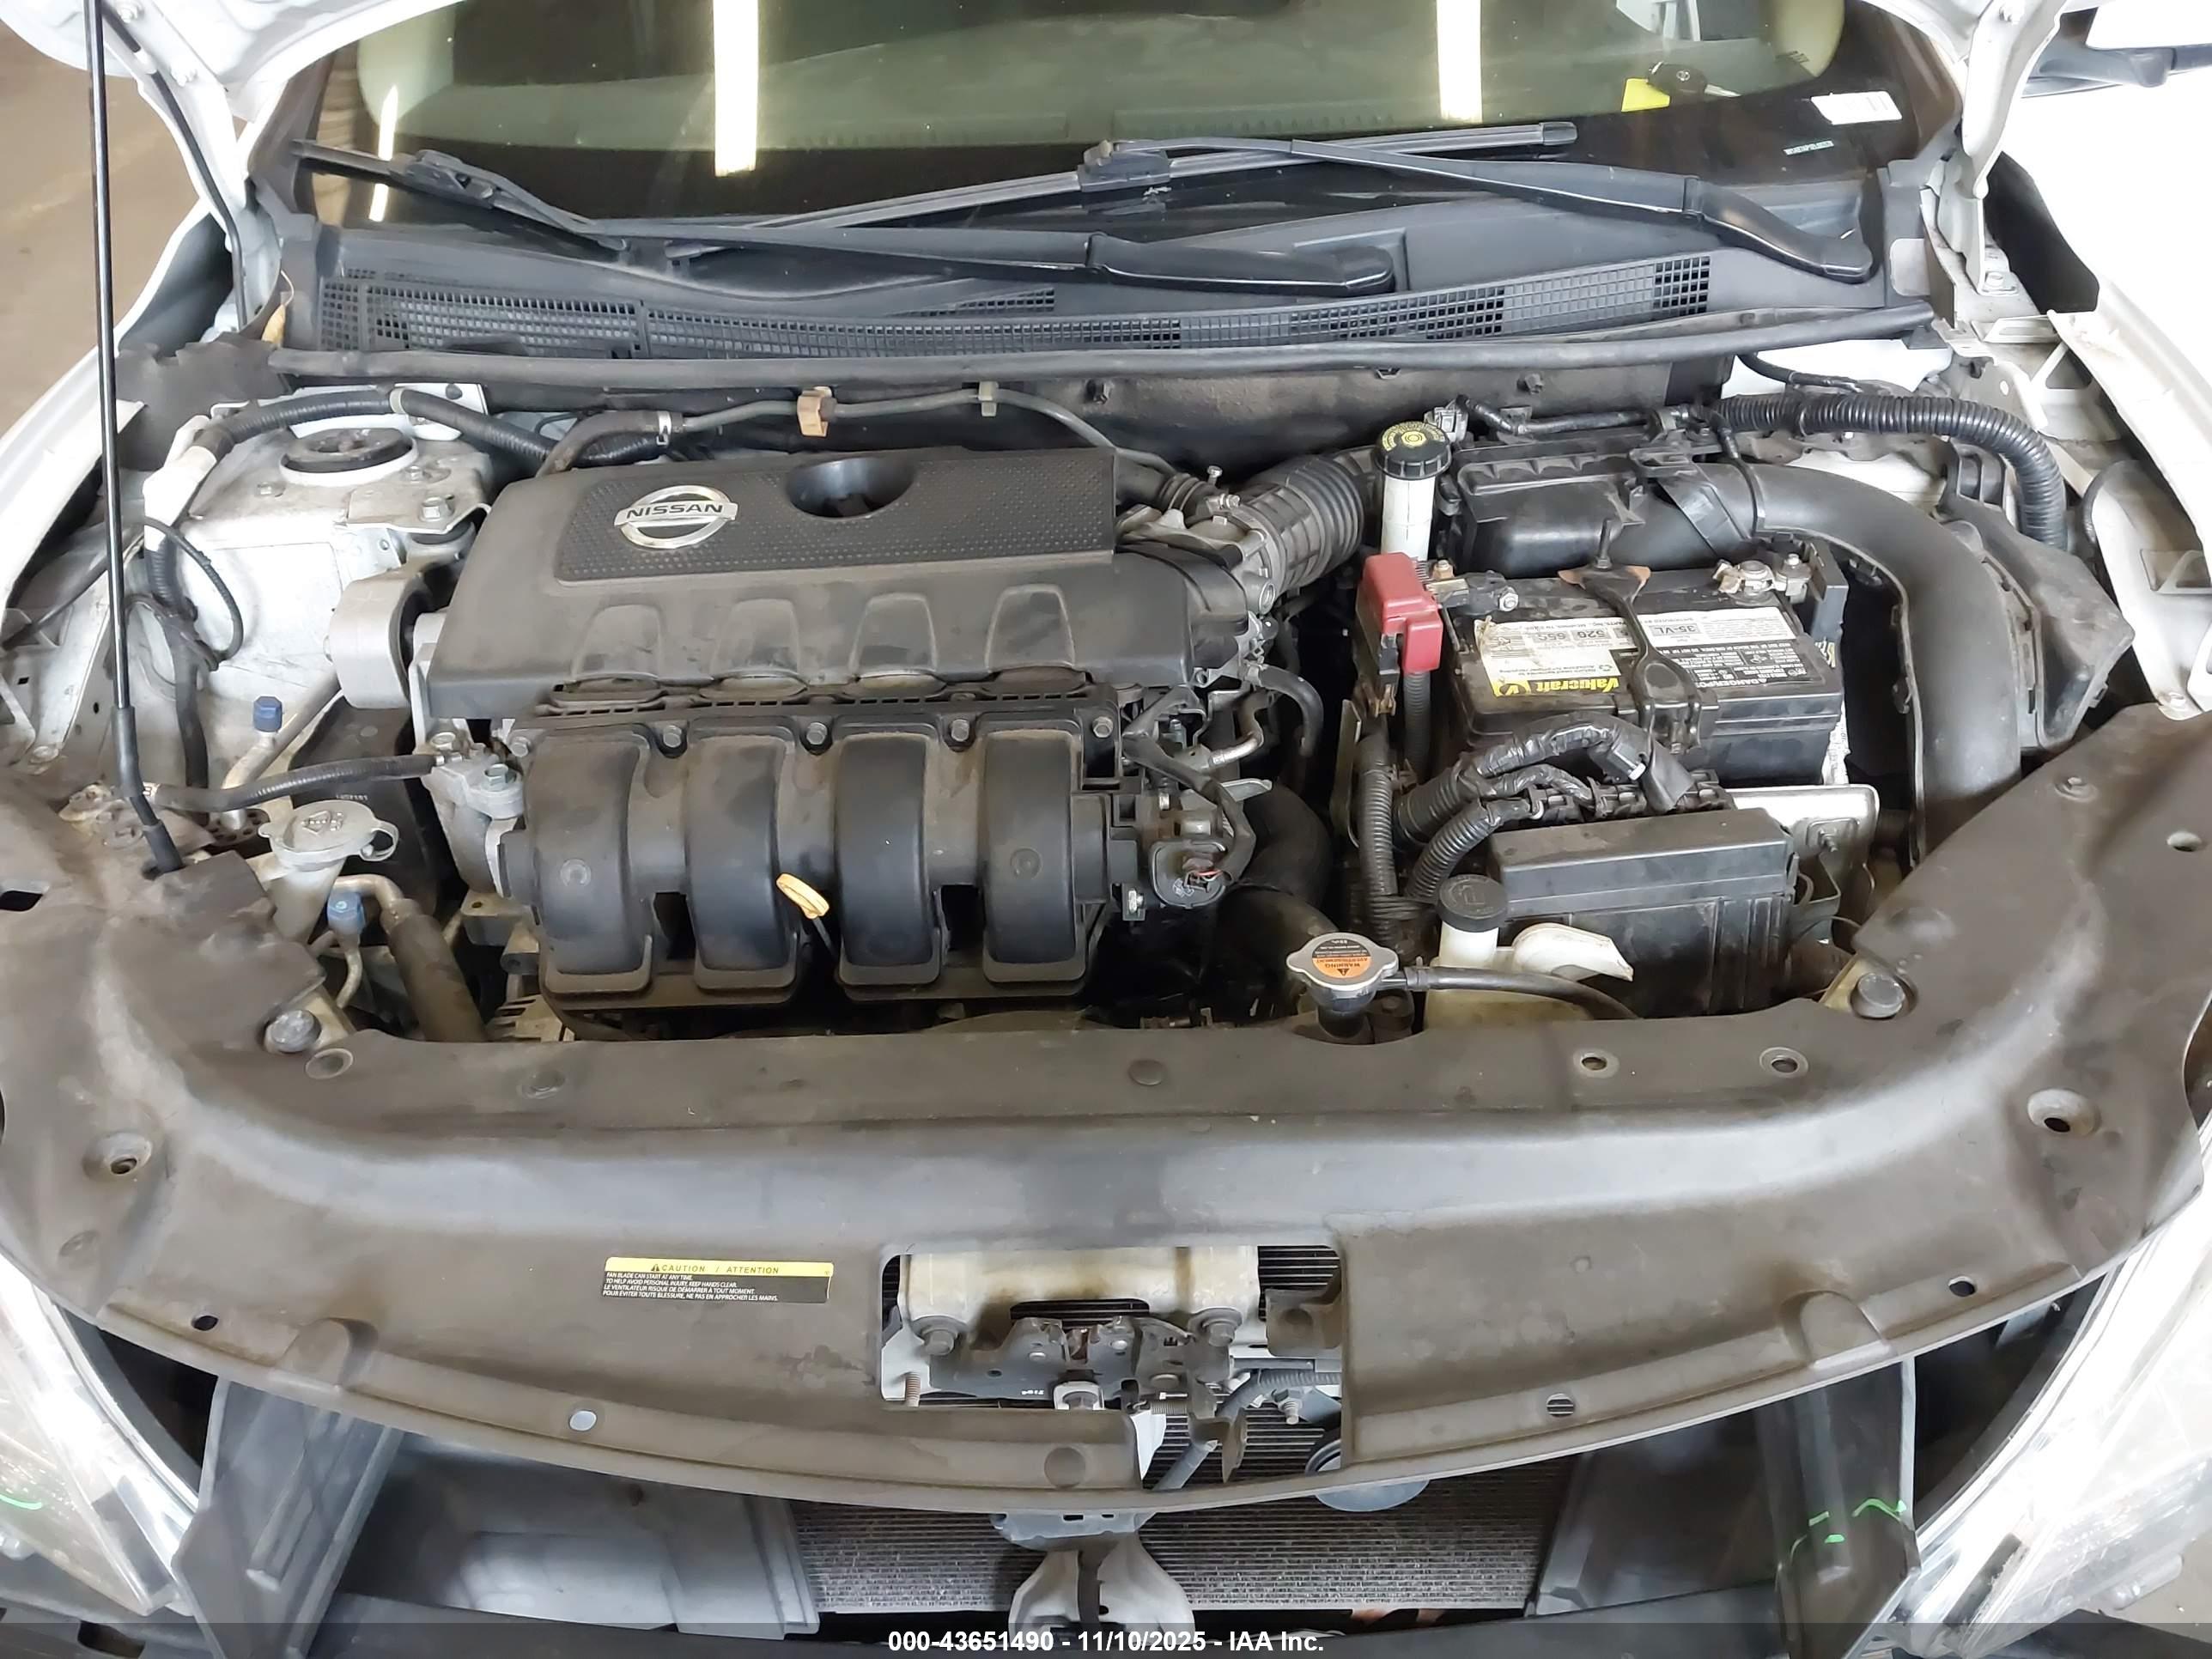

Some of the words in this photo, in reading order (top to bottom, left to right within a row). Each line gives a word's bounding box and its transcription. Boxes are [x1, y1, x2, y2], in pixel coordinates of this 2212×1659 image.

[626, 504, 723, 519] NISSAN
[1655, 625, 1696, 634] 35-VL
[662, 1264, 705, 1273] CAUTION
